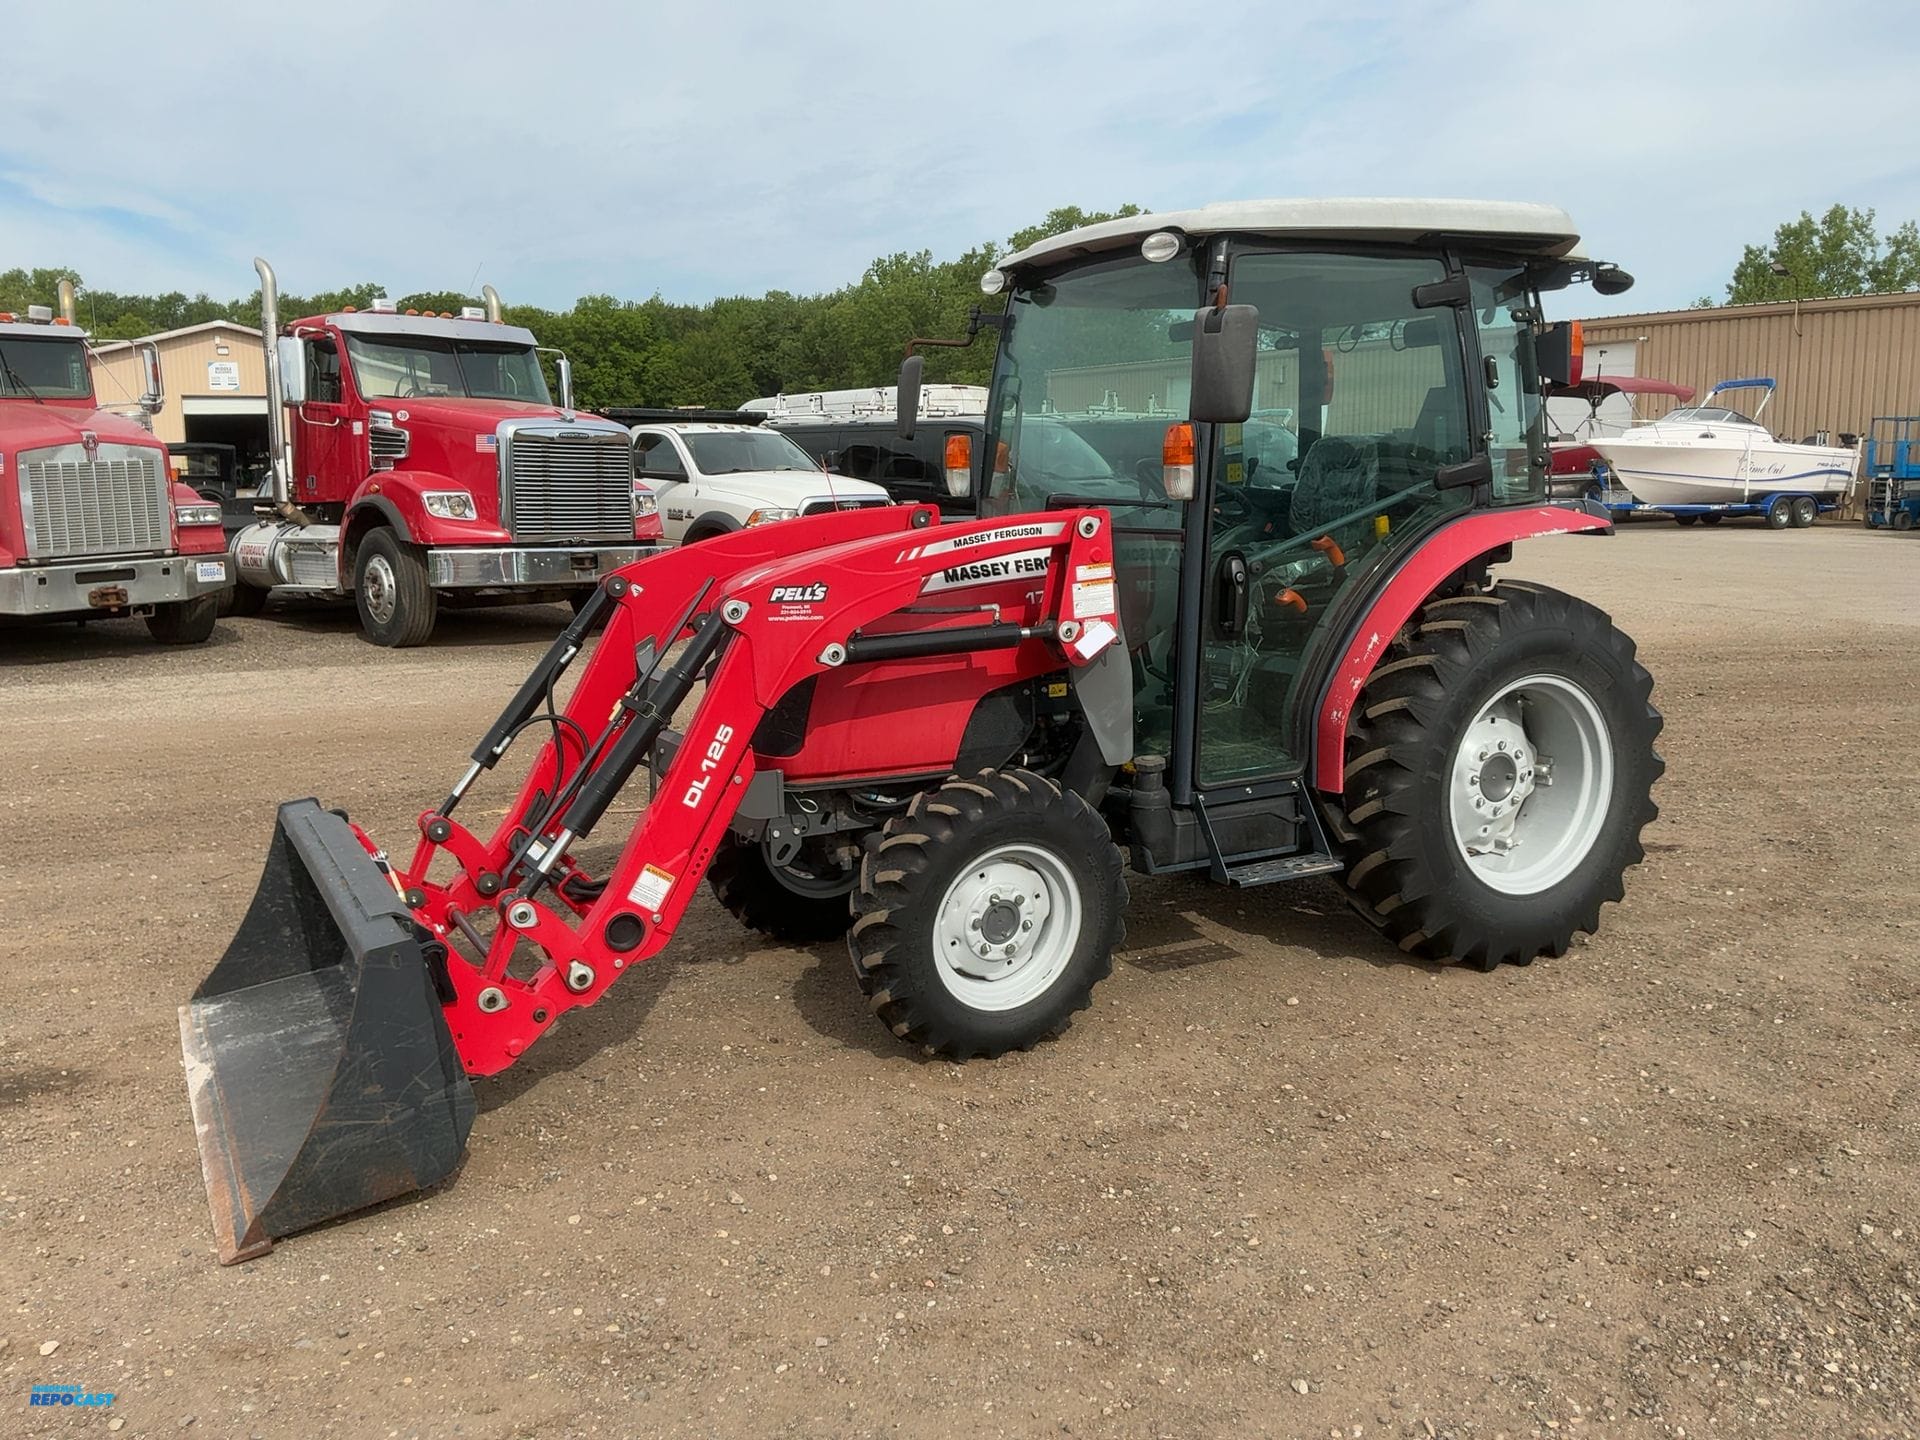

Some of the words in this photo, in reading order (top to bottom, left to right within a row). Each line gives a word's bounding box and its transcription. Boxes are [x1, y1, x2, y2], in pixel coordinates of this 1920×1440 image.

[953, 532, 992, 548] MASSEY
[994, 526, 1043, 541] FERGUSON
[943, 557, 1010, 584] MASSEY
[769, 583, 828, 602] PELL'S
